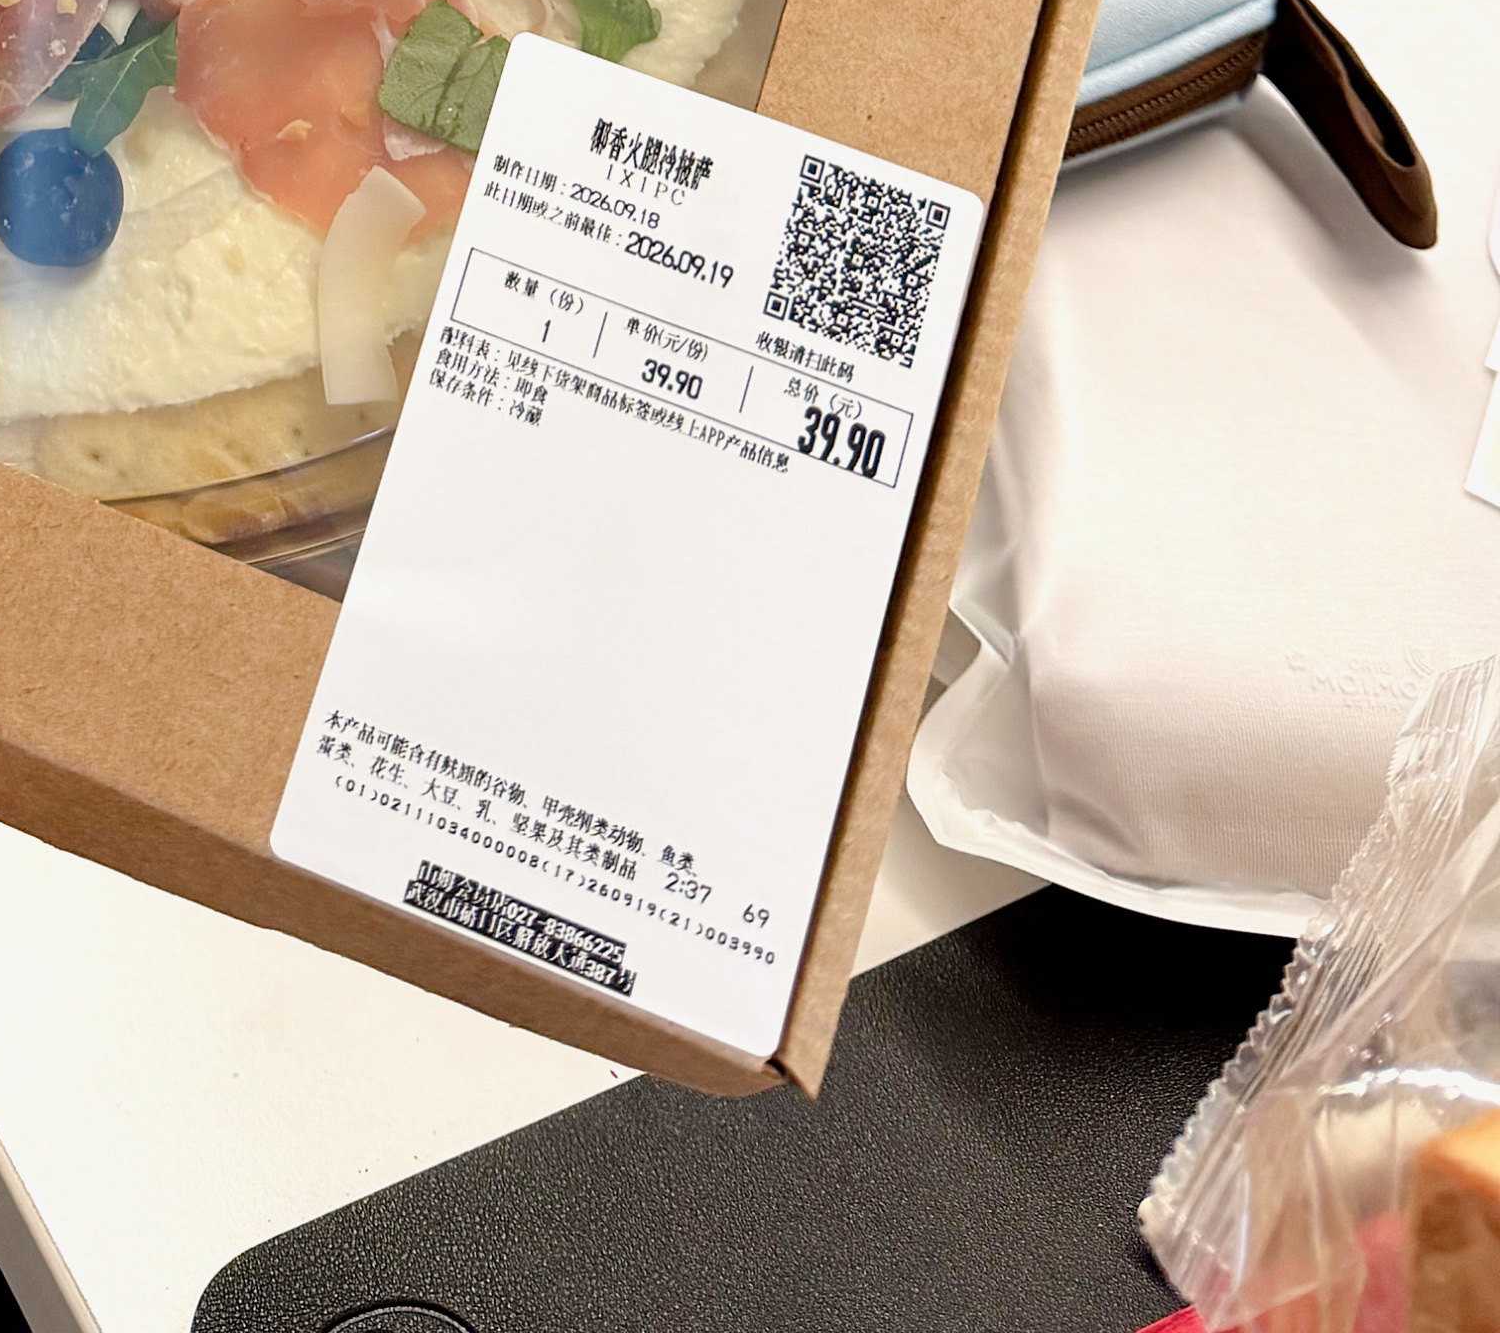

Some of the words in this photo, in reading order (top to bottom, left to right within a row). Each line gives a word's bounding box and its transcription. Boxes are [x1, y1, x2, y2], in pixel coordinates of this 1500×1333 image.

[540, 318, 552, 344] 1
[754, 329, 855, 384] 收银请扫此码
[640, 356, 704, 401] 39.90
[797, 405, 887, 480] 39.90
[662, 870, 713, 905] 2:37
[741, 902, 770, 929] 69
